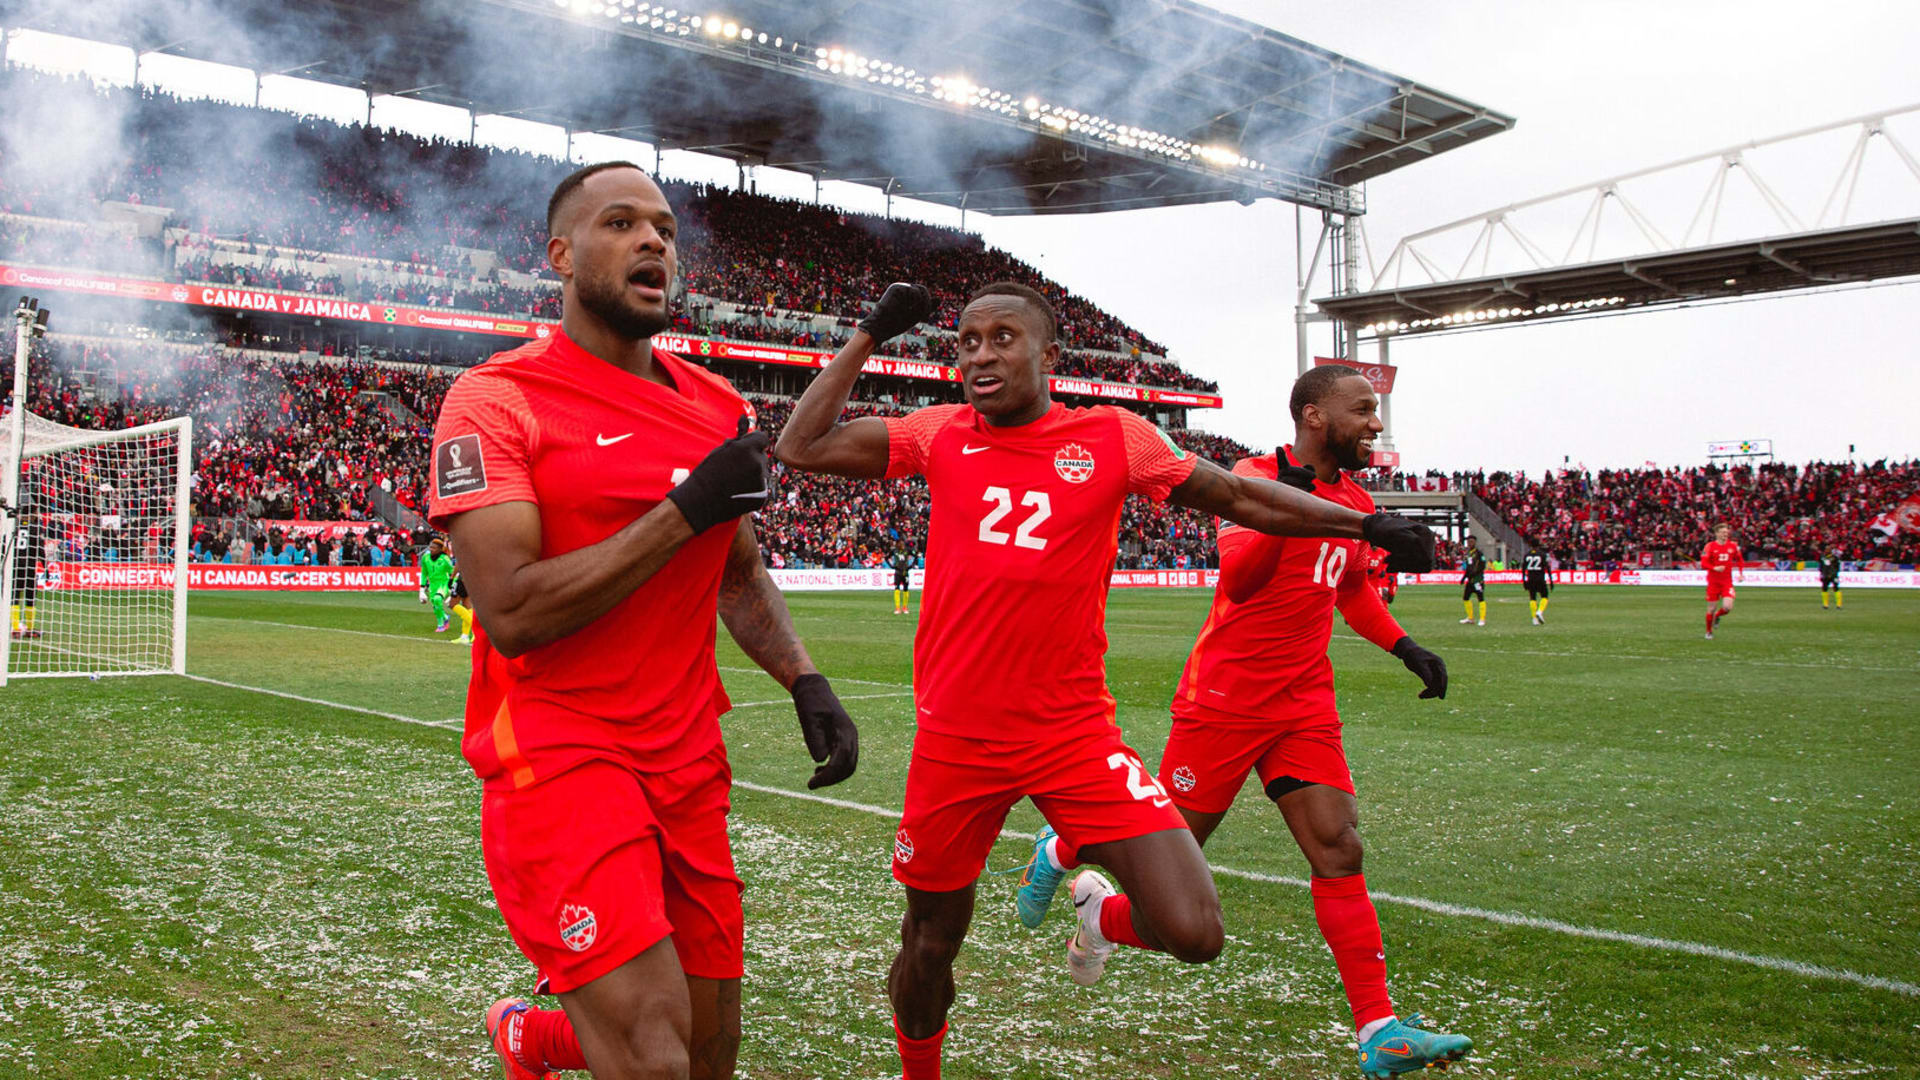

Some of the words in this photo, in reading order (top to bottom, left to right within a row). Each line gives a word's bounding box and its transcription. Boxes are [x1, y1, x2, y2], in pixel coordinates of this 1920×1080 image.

[202, 288, 278, 311] CANADA
[282, 300, 291, 312] v
[294, 298, 371, 321] JAMAICA
[651, 336, 691, 353] MAICA
[861, 359, 884, 373] ADA
[893, 363, 941, 379] JAMAICA
[1055, 380, 1093, 395] CANADA
[1099, 385, 1138, 400] JAMAICA
[1055, 459, 1093, 469] CANADA
[978, 486, 1052, 550] 22
[293, 525, 325, 535] OYOTA
[1313, 542, 1347, 588] 10
[1526, 556, 1542, 570] 22
[78, 569, 158, 585] CONNECT
[159, 569, 201, 585] WH
[204, 570, 268, 586] CANADA
[270, 571, 341, 586] SOCCER'S
[345, 572, 414, 586] NATIONAL
[786, 574, 833, 585] NATIONAL
[836, 574, 867, 585] TEAMS
[1111, 573, 1131, 584] ONAL
[562, 917, 594, 939] CANADA
